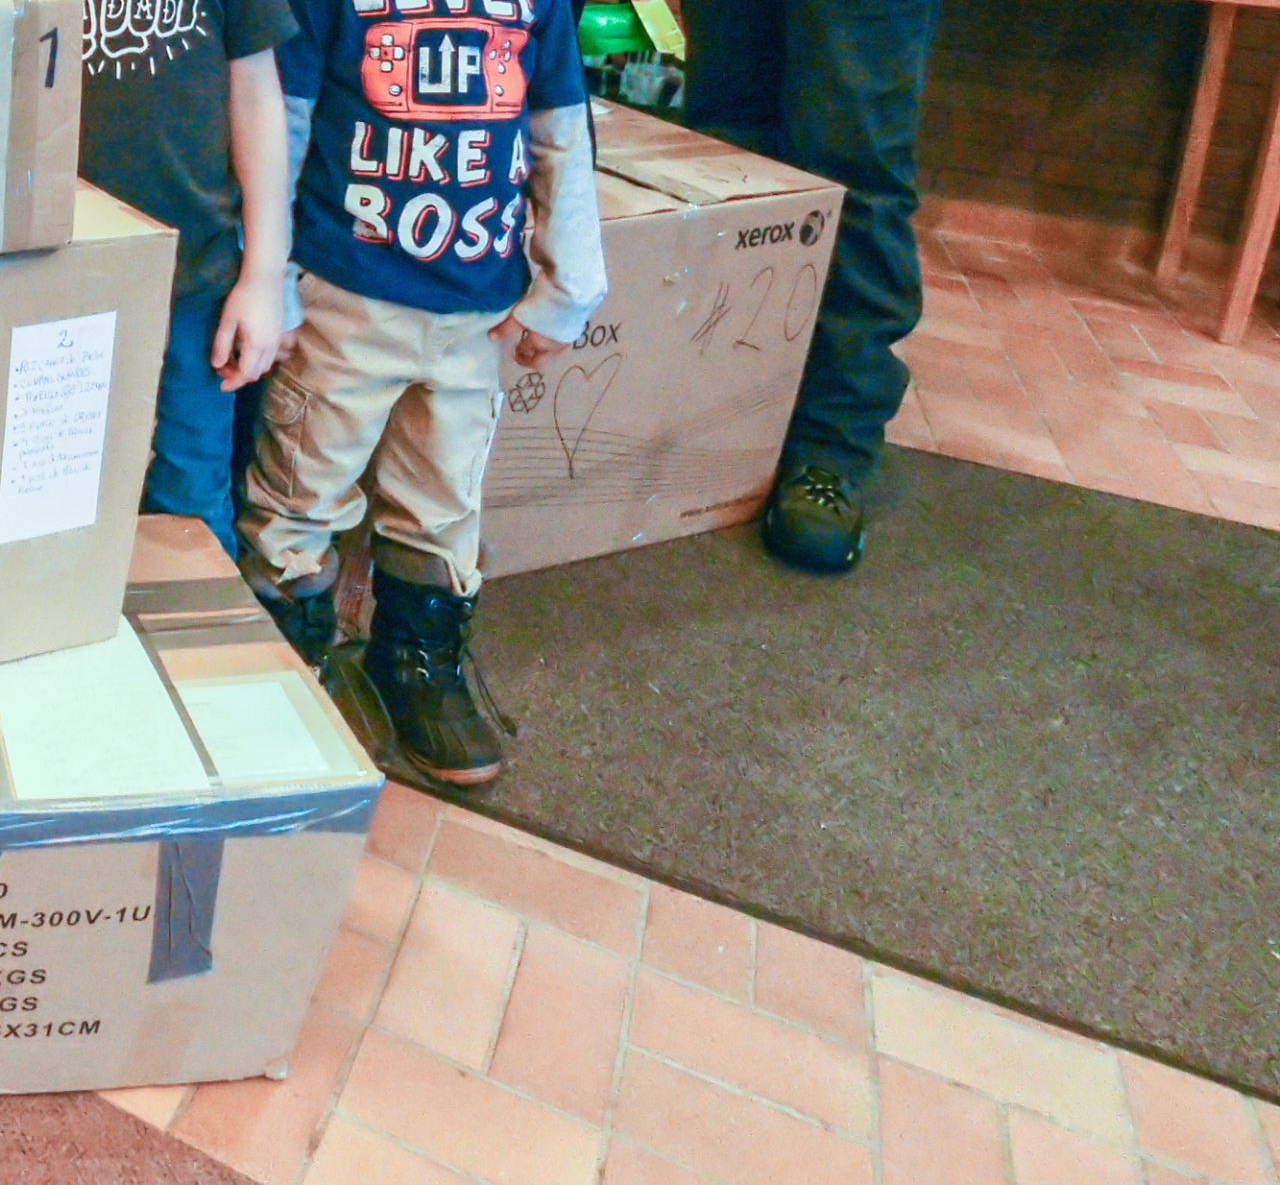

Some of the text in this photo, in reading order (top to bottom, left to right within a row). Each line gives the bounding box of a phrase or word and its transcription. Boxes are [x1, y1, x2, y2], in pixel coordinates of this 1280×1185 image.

[39, 27, 61, 89] 1
[418, 33, 482, 95] UP
[350, 120, 529, 186] LIKE A
[343, 183, 524, 263] BOSS
[734, 219, 795, 250] xerox
[56, 328, 76, 349] 2
